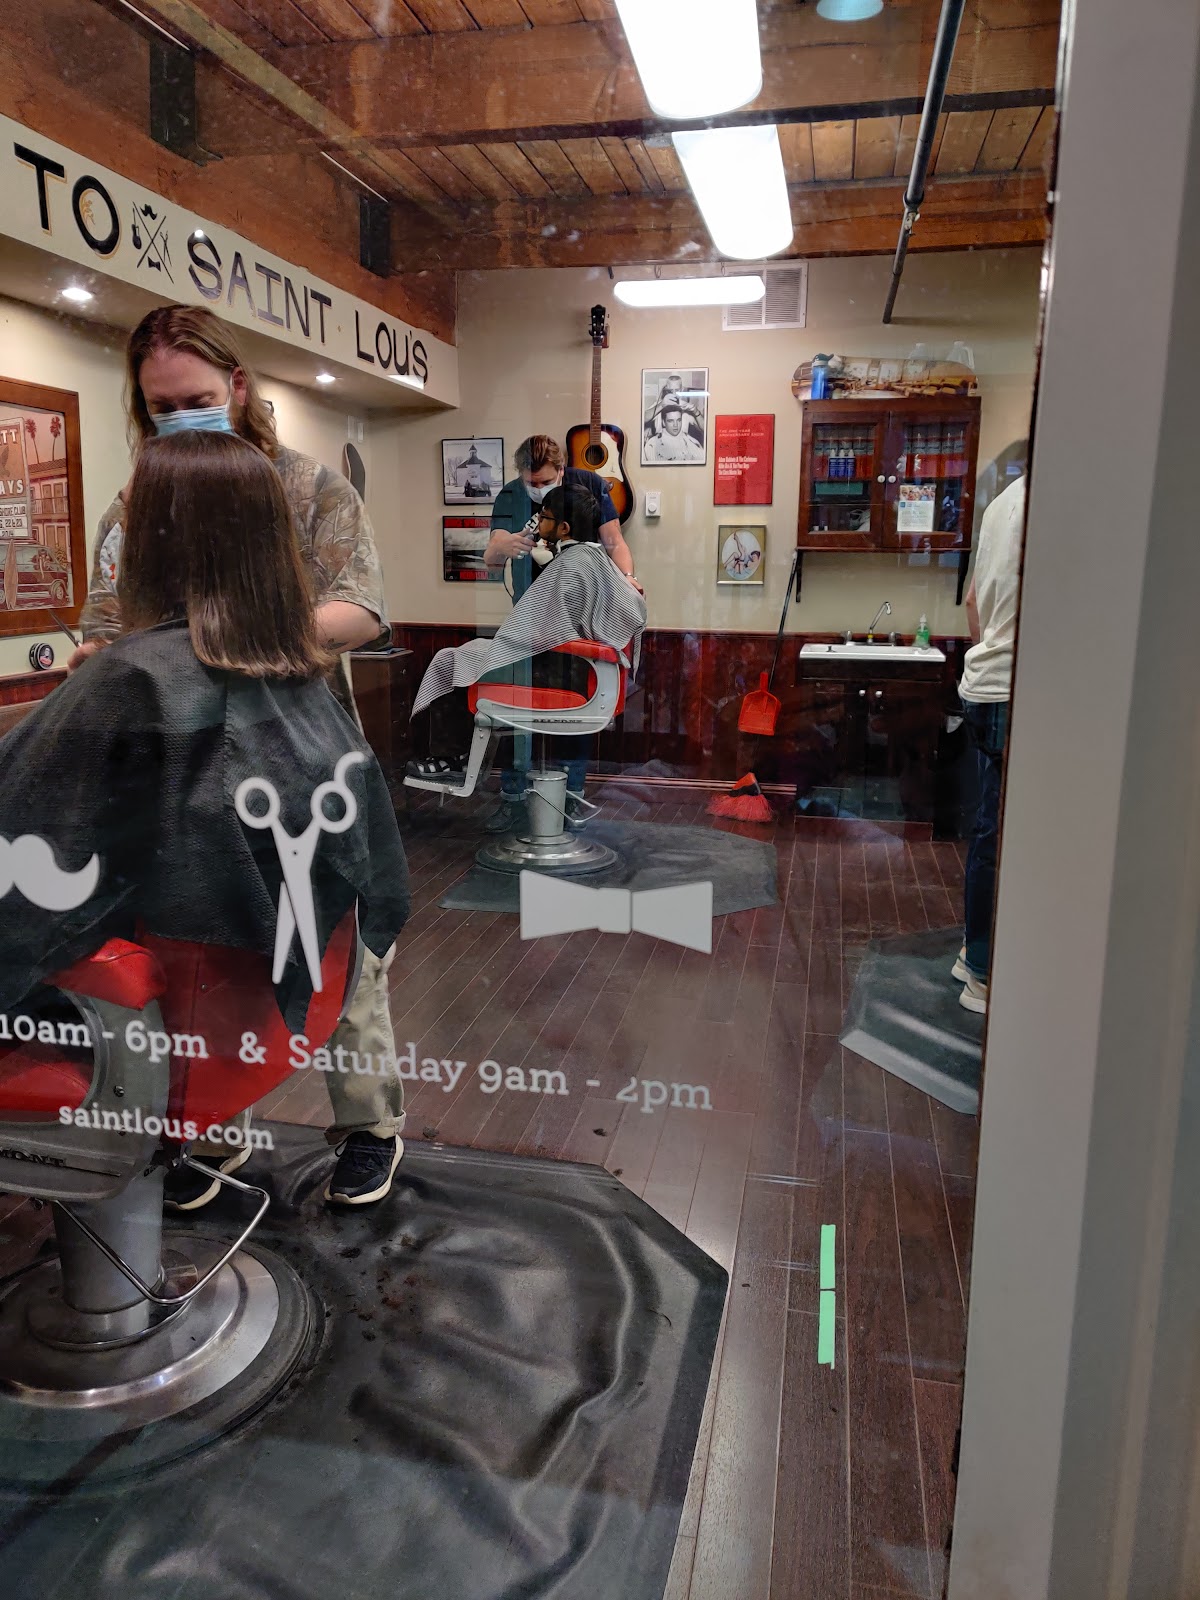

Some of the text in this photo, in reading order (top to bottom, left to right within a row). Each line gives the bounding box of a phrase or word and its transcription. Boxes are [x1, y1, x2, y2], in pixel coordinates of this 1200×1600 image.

[14, 141, 121, 258] TO
[187, 229, 332, 345] SAINT
[102, 1031, 115, 1040] -
[125, 1019, 209, 1064] 6pm
[238, 1030, 267, 1065] &
[288, 1033, 467, 1093] Saturday
[478, 1059, 570, 1096] 9am
[586, 1078, 601, 1087] -
[615, 1076, 714, 1114] 2pm
[58, 1102, 275, 1151] saintlous.com
